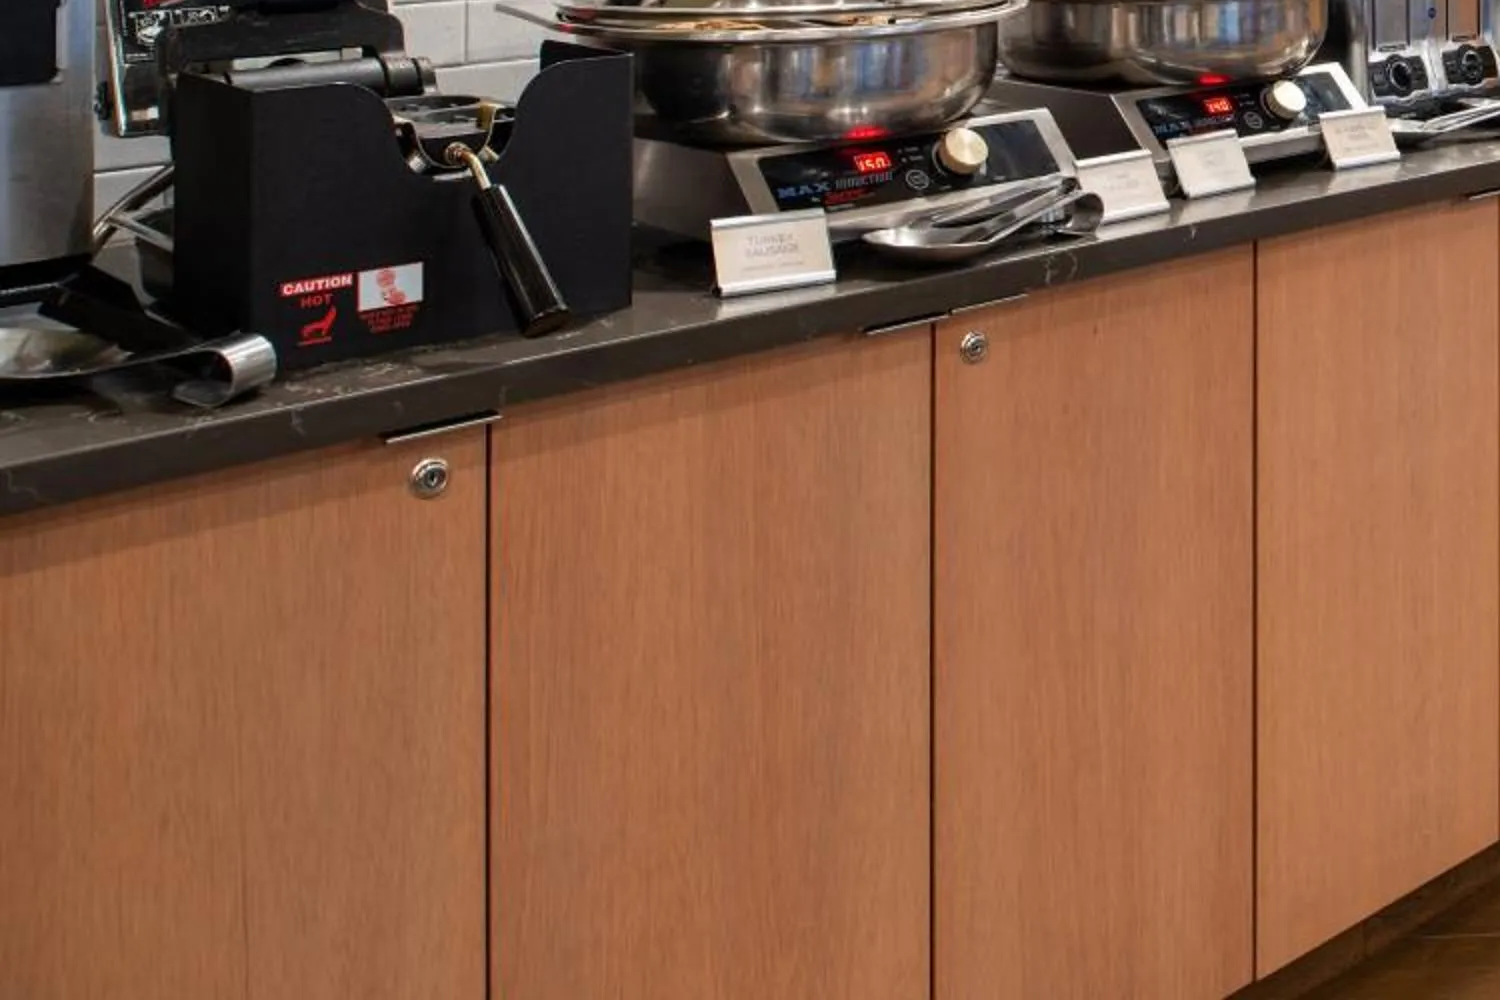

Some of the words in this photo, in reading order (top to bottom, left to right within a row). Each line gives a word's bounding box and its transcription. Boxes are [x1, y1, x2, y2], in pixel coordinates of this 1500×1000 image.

[777, 182, 830, 200] MAX
[282, 273, 354, 296] CAUTION
[301, 293, 333, 308] HOT
